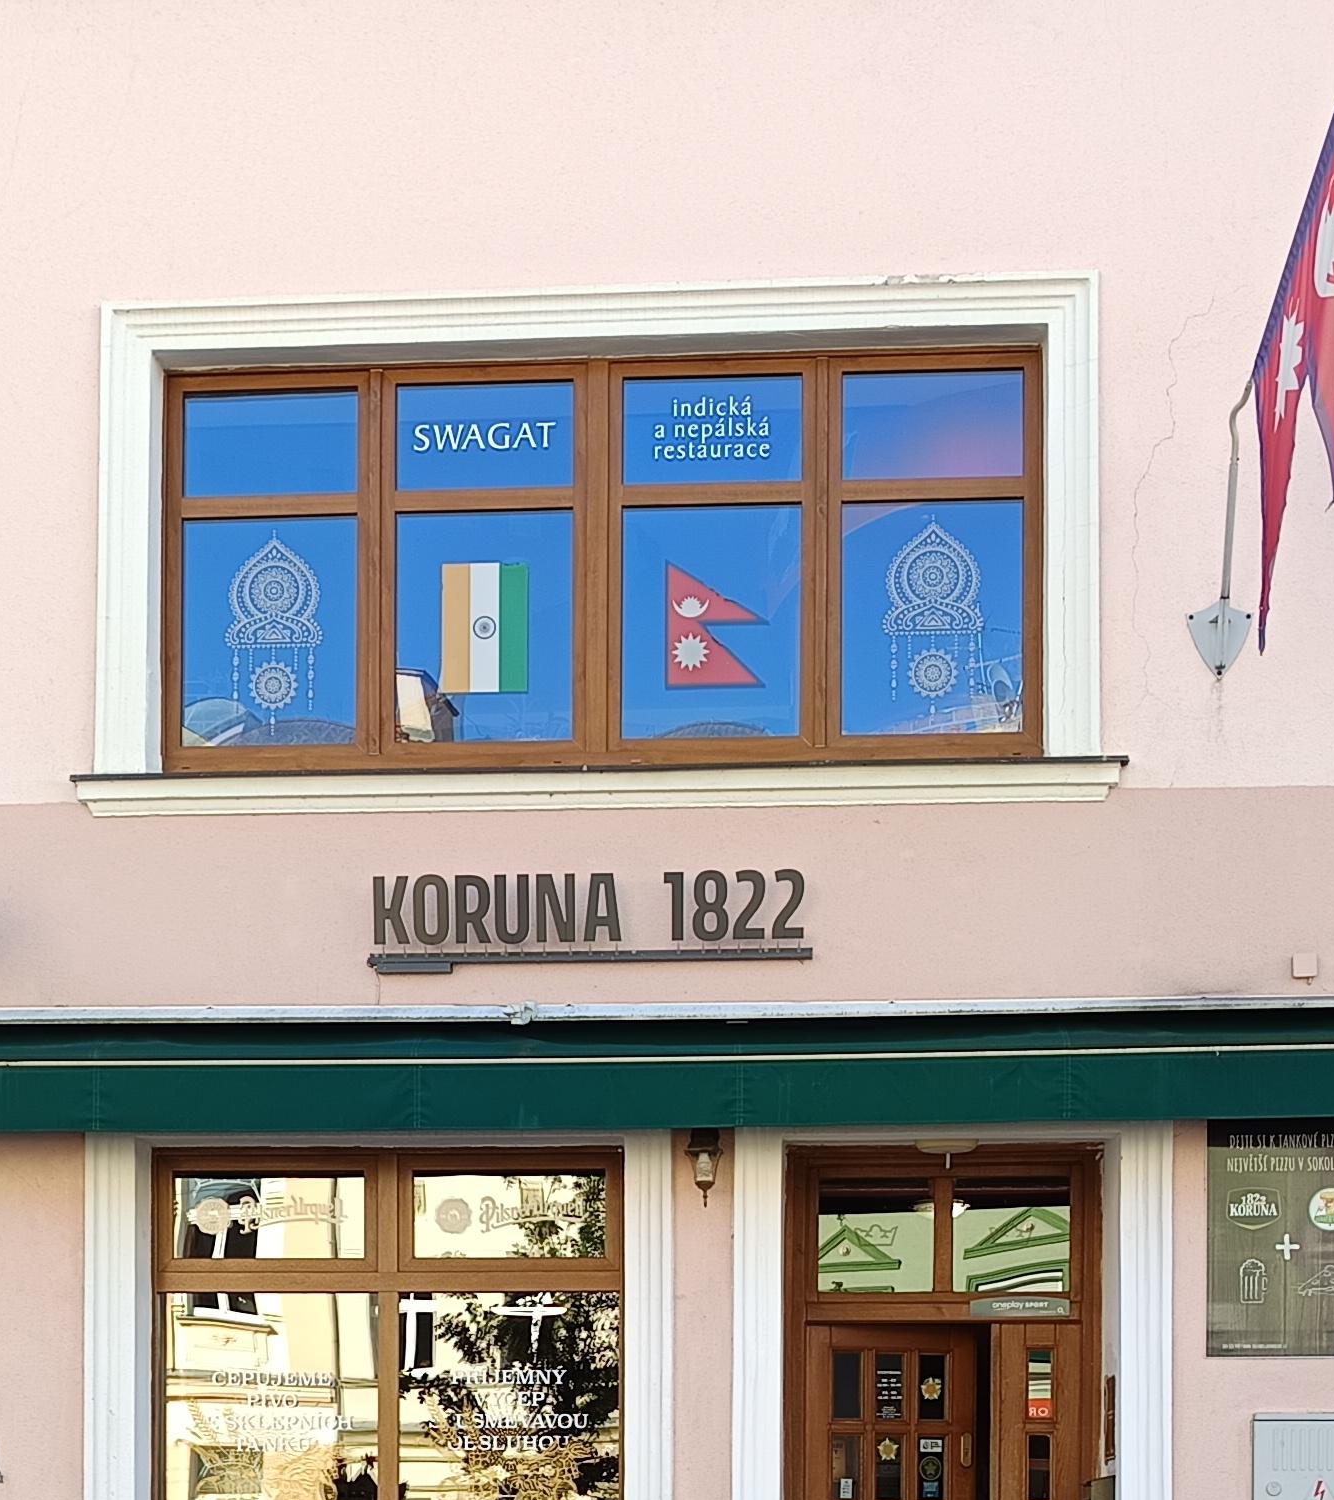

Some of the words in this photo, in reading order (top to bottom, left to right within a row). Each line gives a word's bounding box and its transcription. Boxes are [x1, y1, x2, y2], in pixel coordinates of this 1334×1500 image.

[673, 396, 752, 417] indická
[413, 422, 556, 453] SWAGAT
[654, 424, 665, 440] a
[674, 417, 769, 444] nepálská
[654, 442, 770, 460] restaurace
[372, 873, 622, 945] KORUNA
[663, 869, 806, 942] 1822
[1229, 1134, 1254, 1150] DEJTE
[1269, 1134, 1276, 1148] K
[1279, 1131, 1318, 1149] TANKOVÉ
[1227, 1153, 1268, 1173] NEJVĚTŠÍ
[1270, 1157, 1295, 1172] PIZZU
[1298, 1157, 1304, 1171] V
[1241, 1193, 1267, 1205] 1822
[1229, 1203, 1278, 1217] KORUNA
[247, 1393, 300, 1408] PIVO
